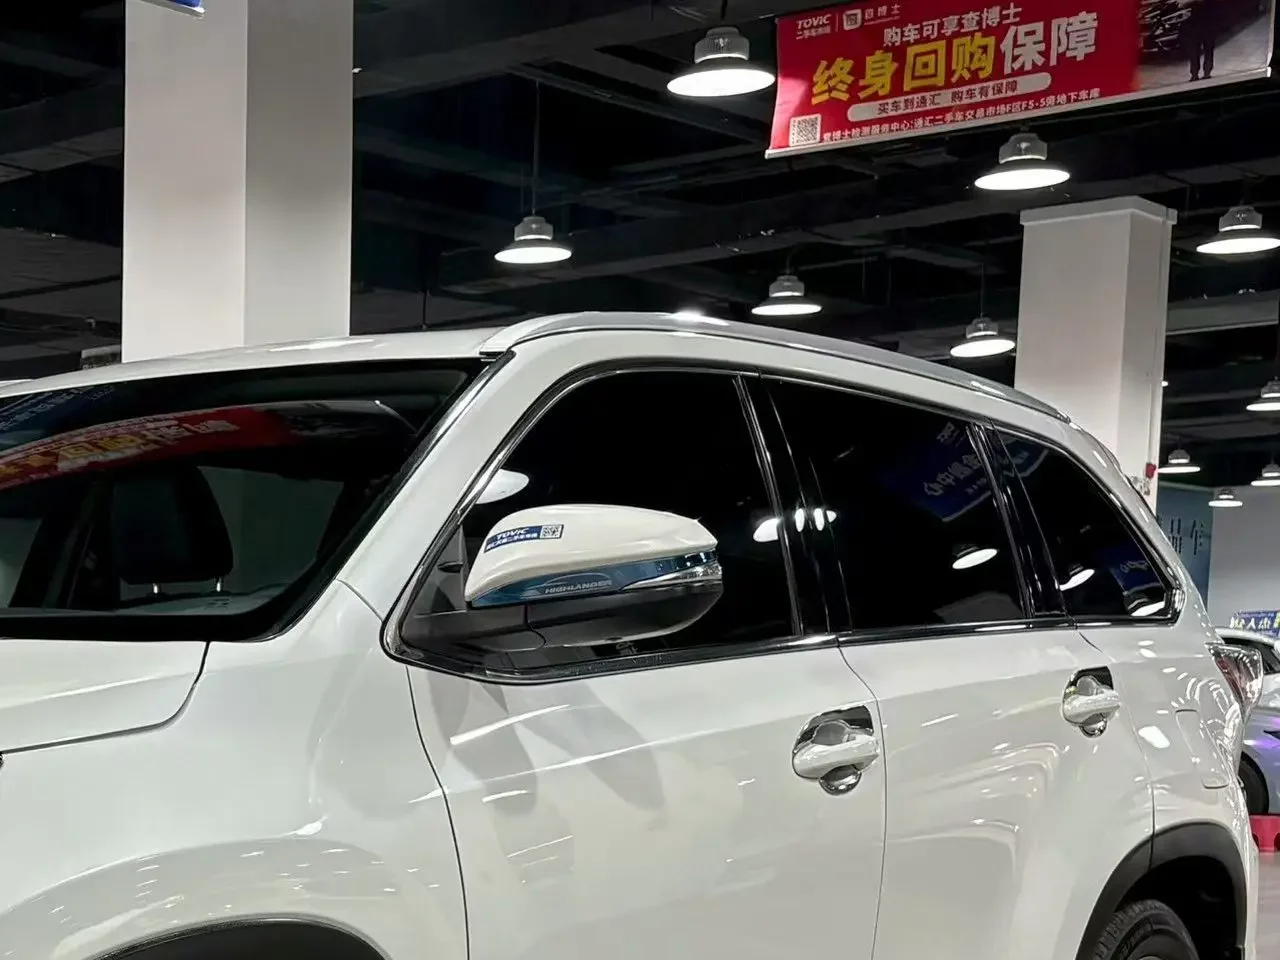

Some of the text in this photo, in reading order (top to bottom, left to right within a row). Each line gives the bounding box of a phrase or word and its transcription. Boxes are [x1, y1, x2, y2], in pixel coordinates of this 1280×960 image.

[796, 14, 832, 29] TOVIC
[883, 3, 1020, 47] 购车可享查博士
[811, 11, 1099, 105] 终身回购保障
[950, 80, 1018, 103] 购车有保障
[496, 527, 530, 540] TOVIC
[544, 579, 613, 594] HIGHLANDER
